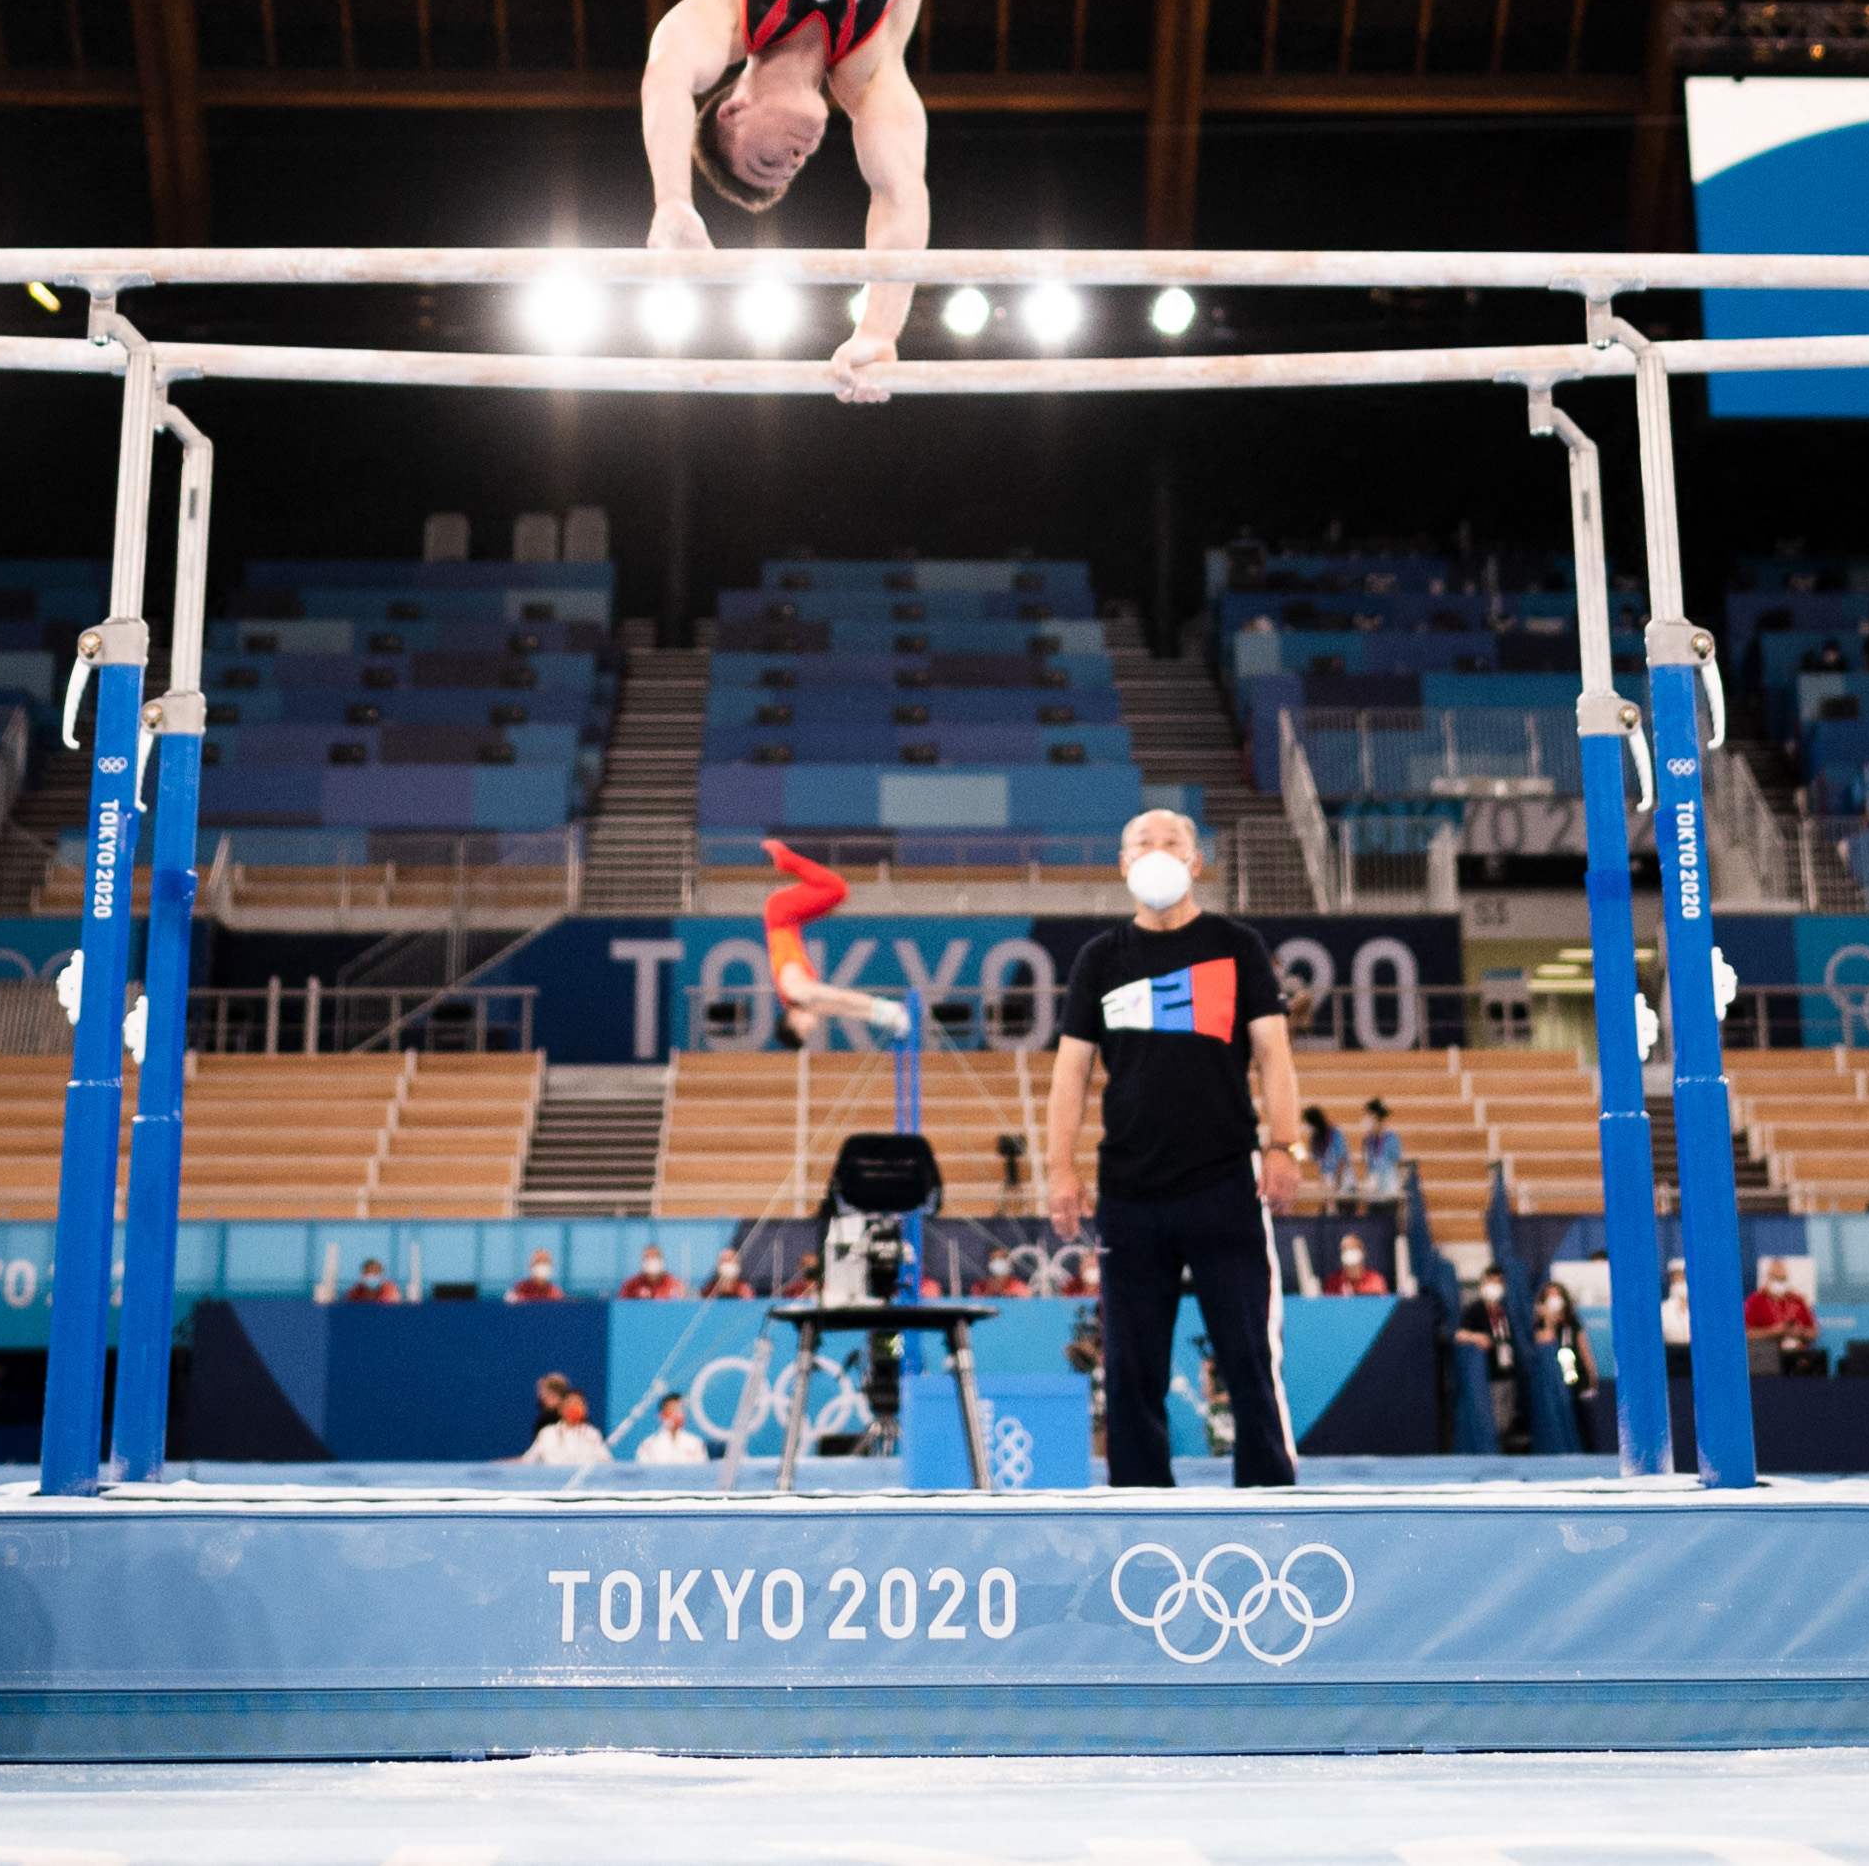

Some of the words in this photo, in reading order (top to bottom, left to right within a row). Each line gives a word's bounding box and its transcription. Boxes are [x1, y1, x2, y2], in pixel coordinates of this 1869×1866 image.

[96, 798, 120, 866] TOKYO
[1675, 799, 1698, 867] TOKYO
[93, 868, 115, 919] 2020
[1680, 869, 1701, 920] 2020
[609, 937, 1062, 1062] TOKYO
[548, 1568, 806, 1644] TOKYO
[827, 1566, 1017, 1641] 2020
